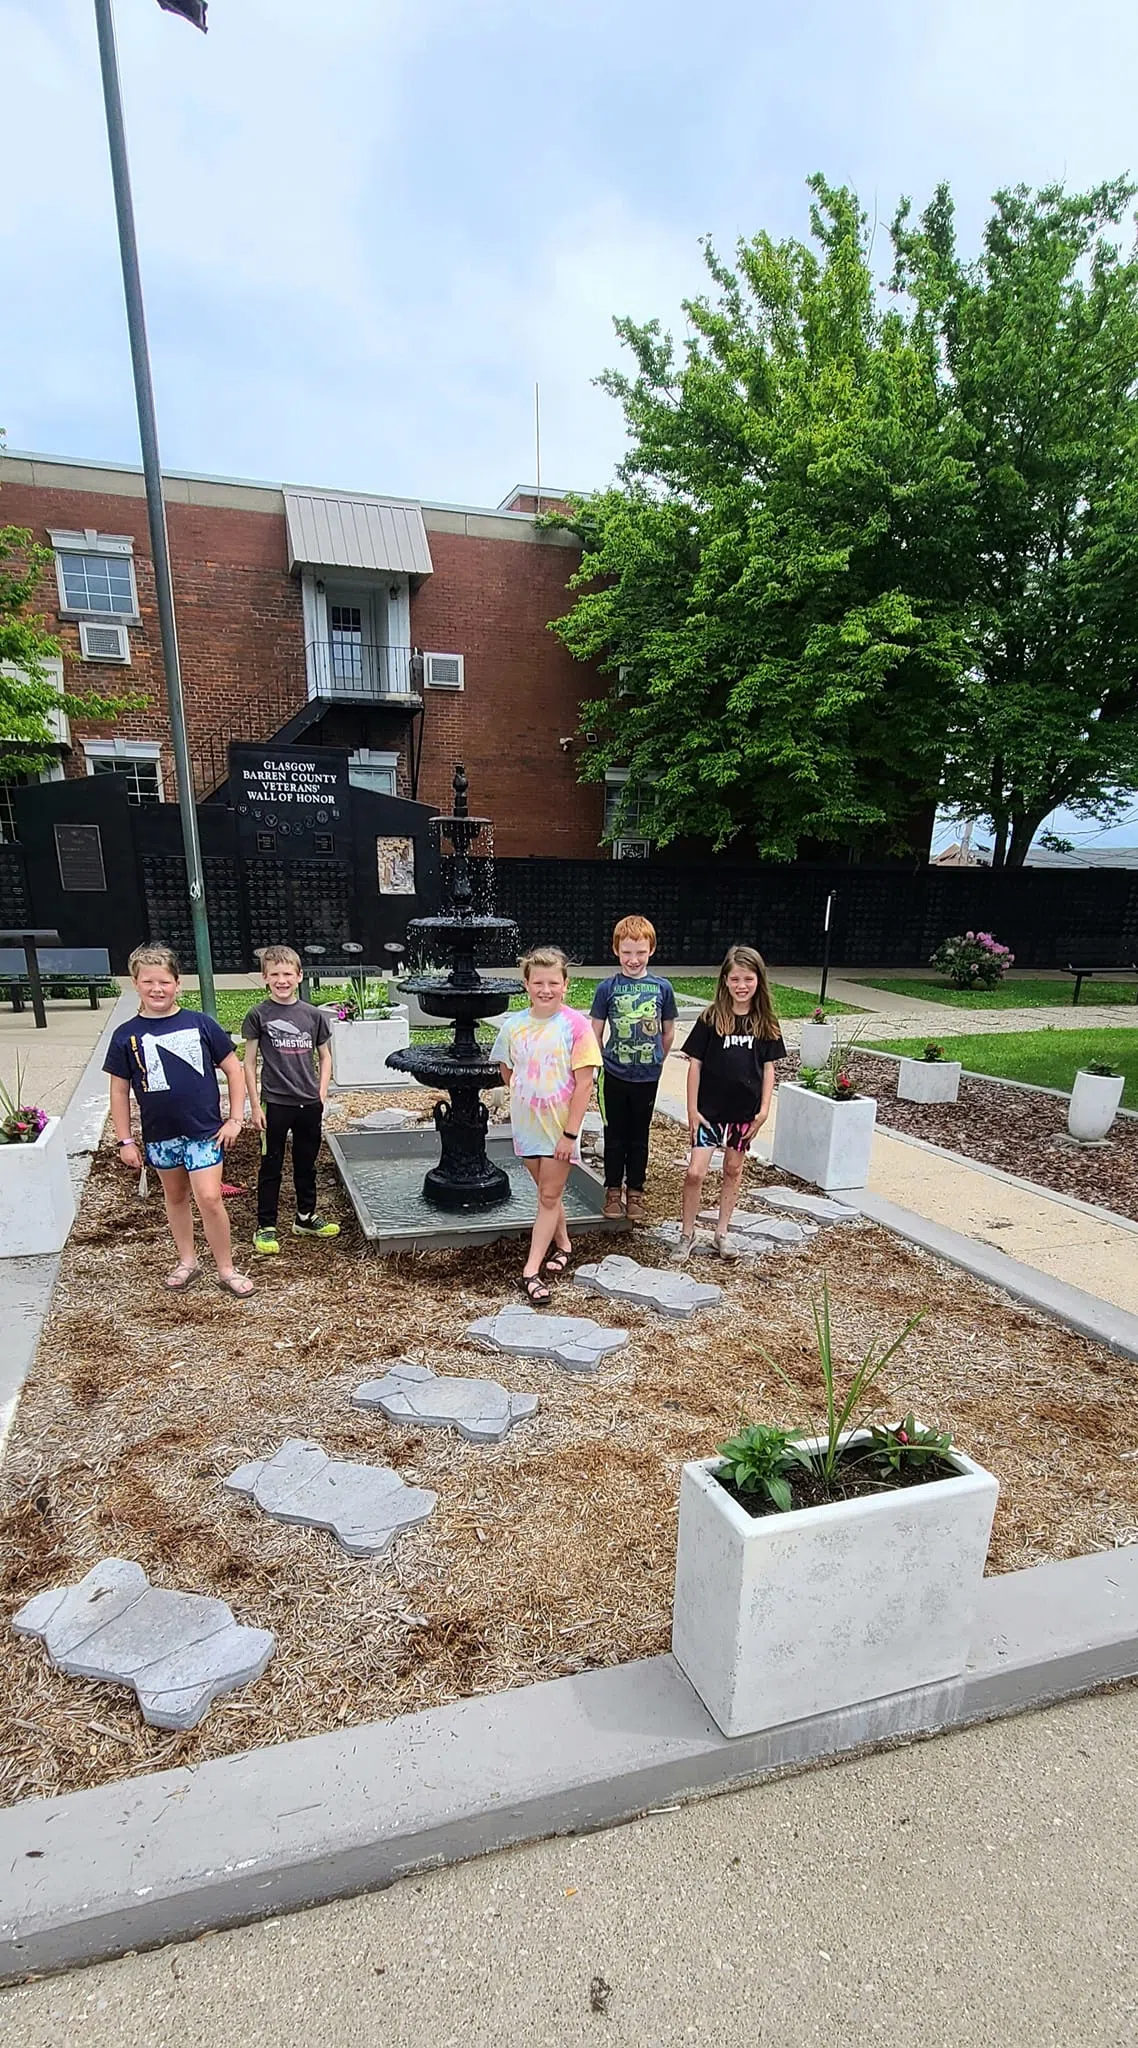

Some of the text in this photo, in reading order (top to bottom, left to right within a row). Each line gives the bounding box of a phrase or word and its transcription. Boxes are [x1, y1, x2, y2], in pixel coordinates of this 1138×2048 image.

[263, 760, 316, 772] GLASGOW
[243, 770, 337, 784] BARREN COUNTY
[261, 782, 320, 793] VETERANS'
[247, 791, 335, 804] WALL OF HONOR
[271, 1039, 313, 1049] TOMBSTONE
